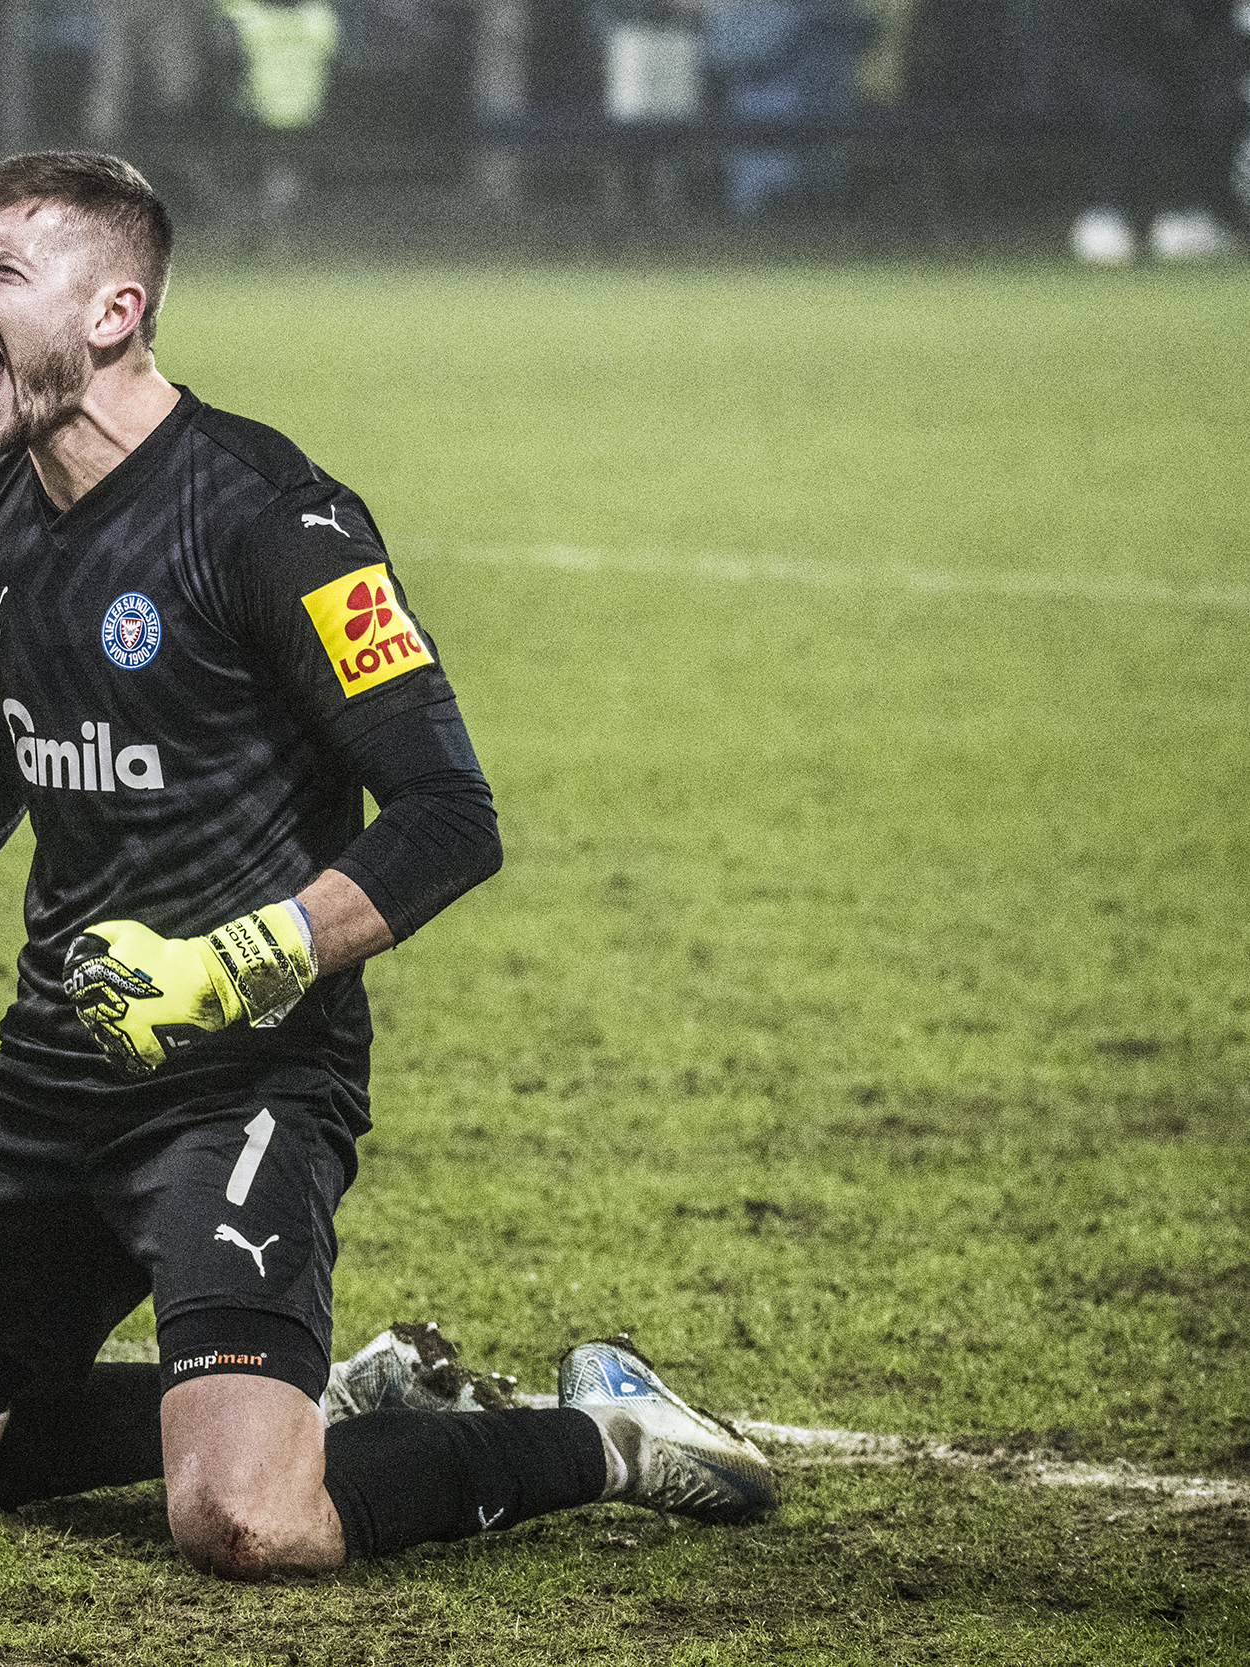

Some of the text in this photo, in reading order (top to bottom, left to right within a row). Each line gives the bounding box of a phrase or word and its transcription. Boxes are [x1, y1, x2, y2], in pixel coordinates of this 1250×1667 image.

[104, 603, 125, 642] KIELER
[134, 598, 158, 646] HOLSTEIN
[110, 642, 150, 665] VON 1900
[339, 630, 423, 684] LOTTO
[225, 1107, 276, 1207] 1
